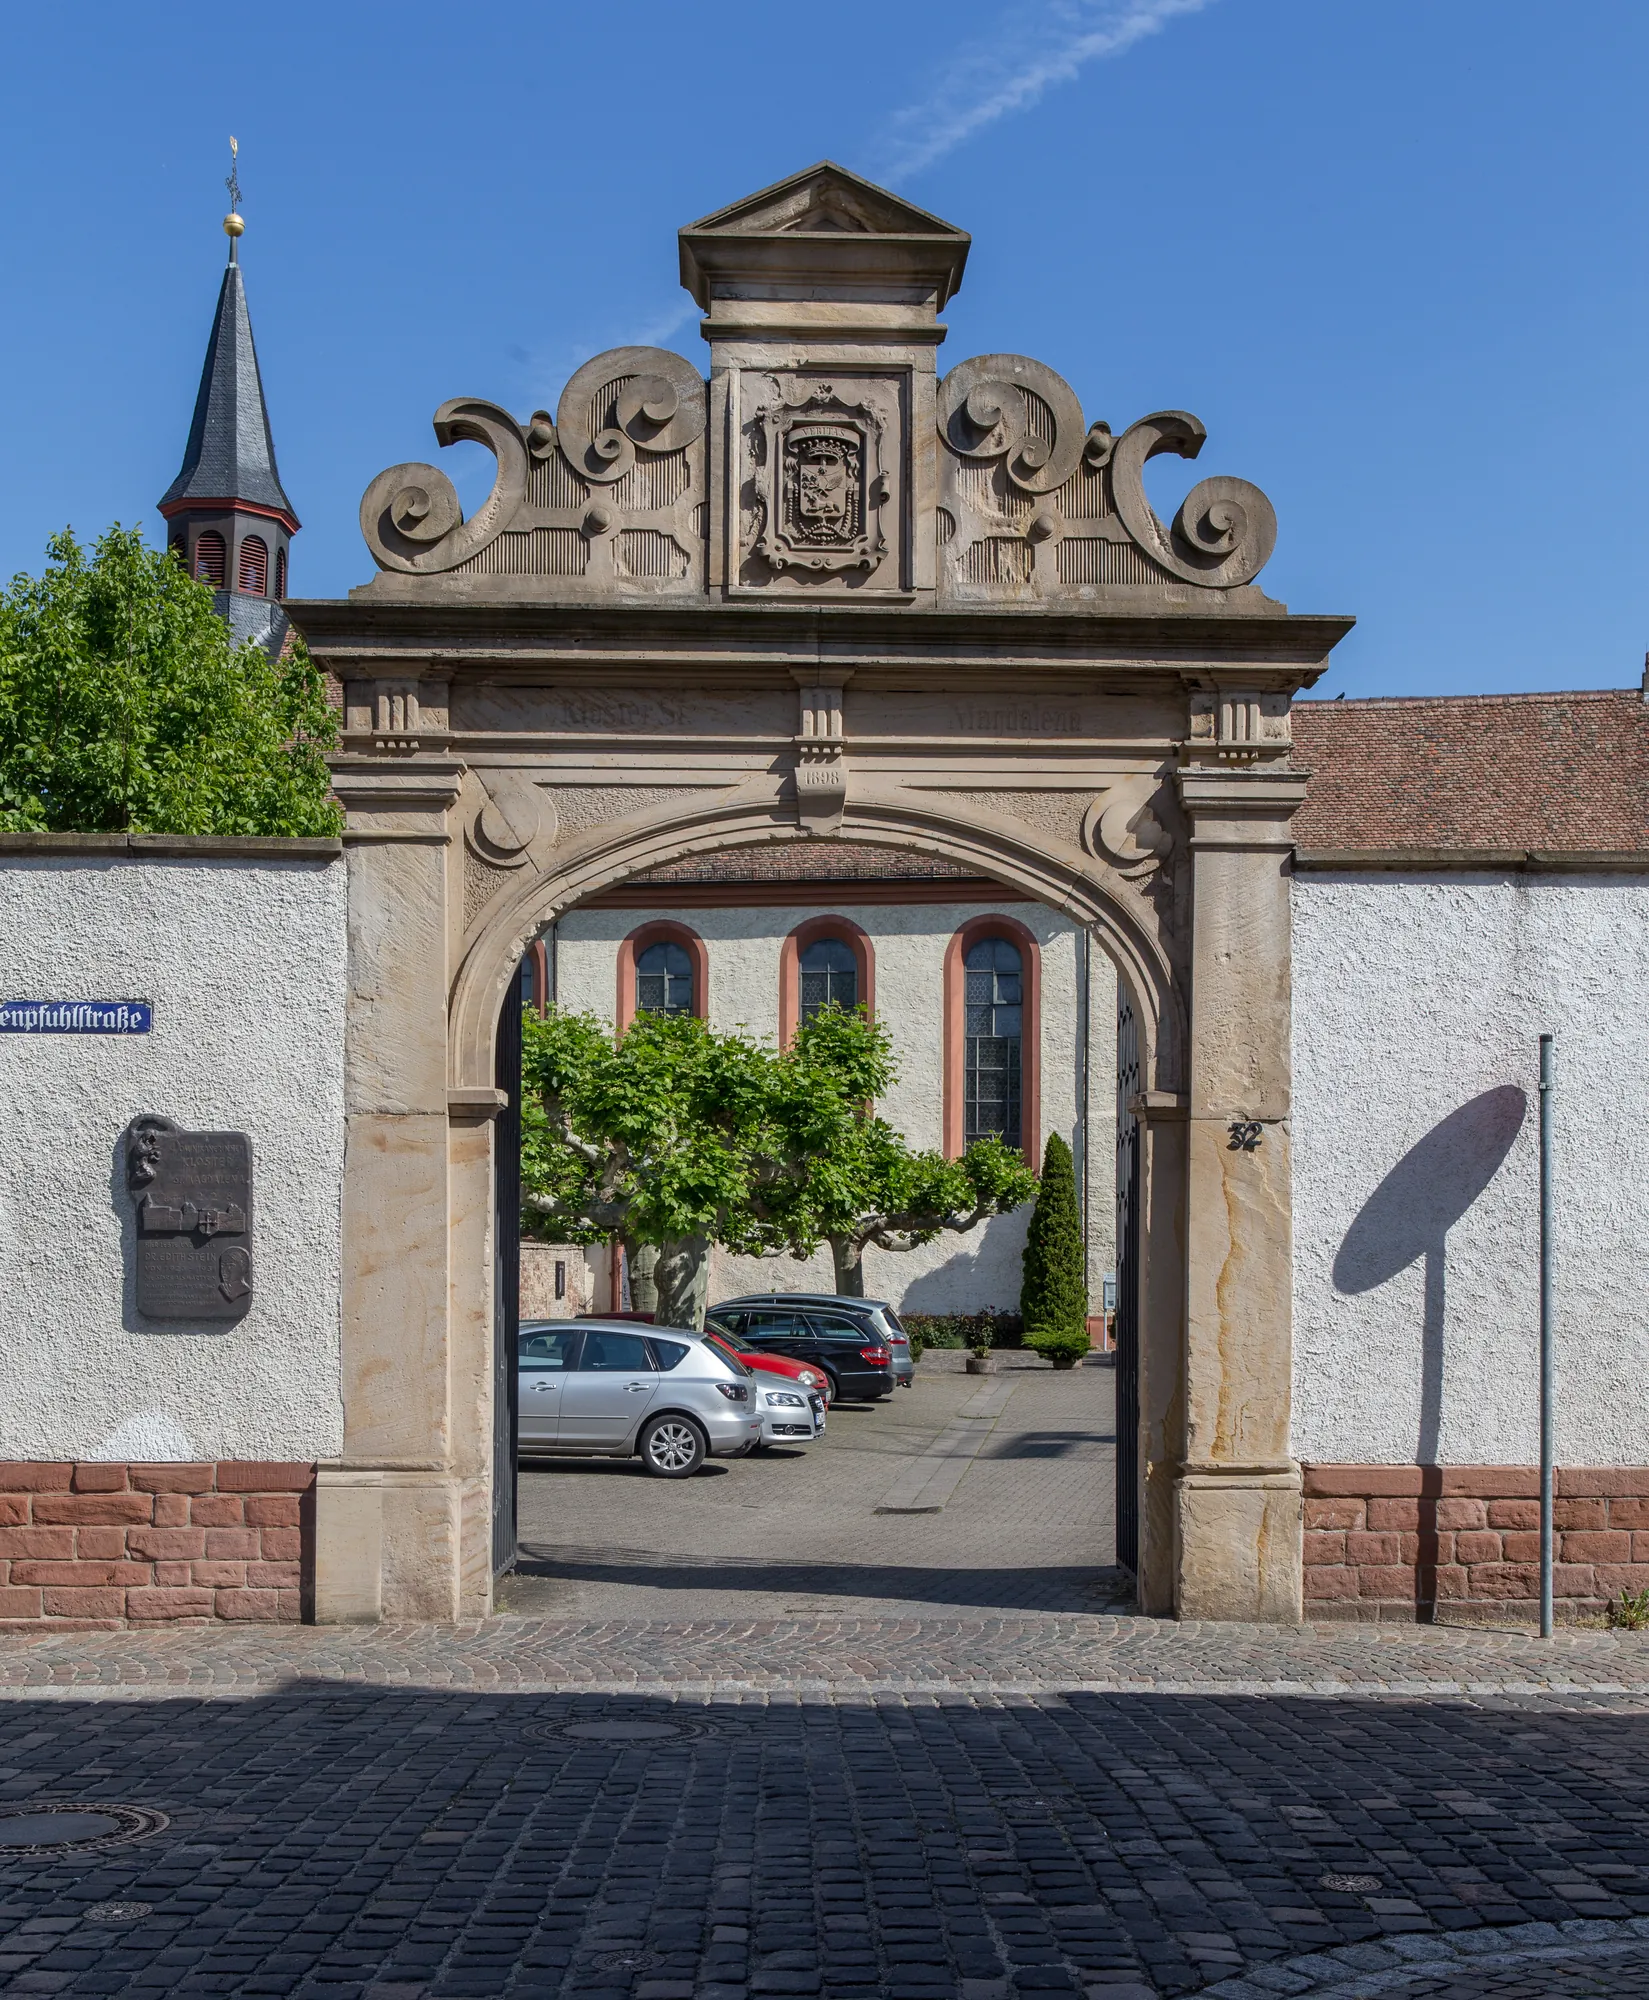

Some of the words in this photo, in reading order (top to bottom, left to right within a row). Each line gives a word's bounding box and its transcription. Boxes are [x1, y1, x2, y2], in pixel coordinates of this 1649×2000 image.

[802, 426, 846, 438] VERITAS
[947, 703, 1083, 735] Magdalena
[804, 771, 839, 785] 1898
[0, 1004, 142, 1033] enpfuhlstraße
[181, 1156, 233, 1167] KLOSTER
[160, 1252, 186, 1261] EDITH
[187, 1252, 216, 1261] STEIN
